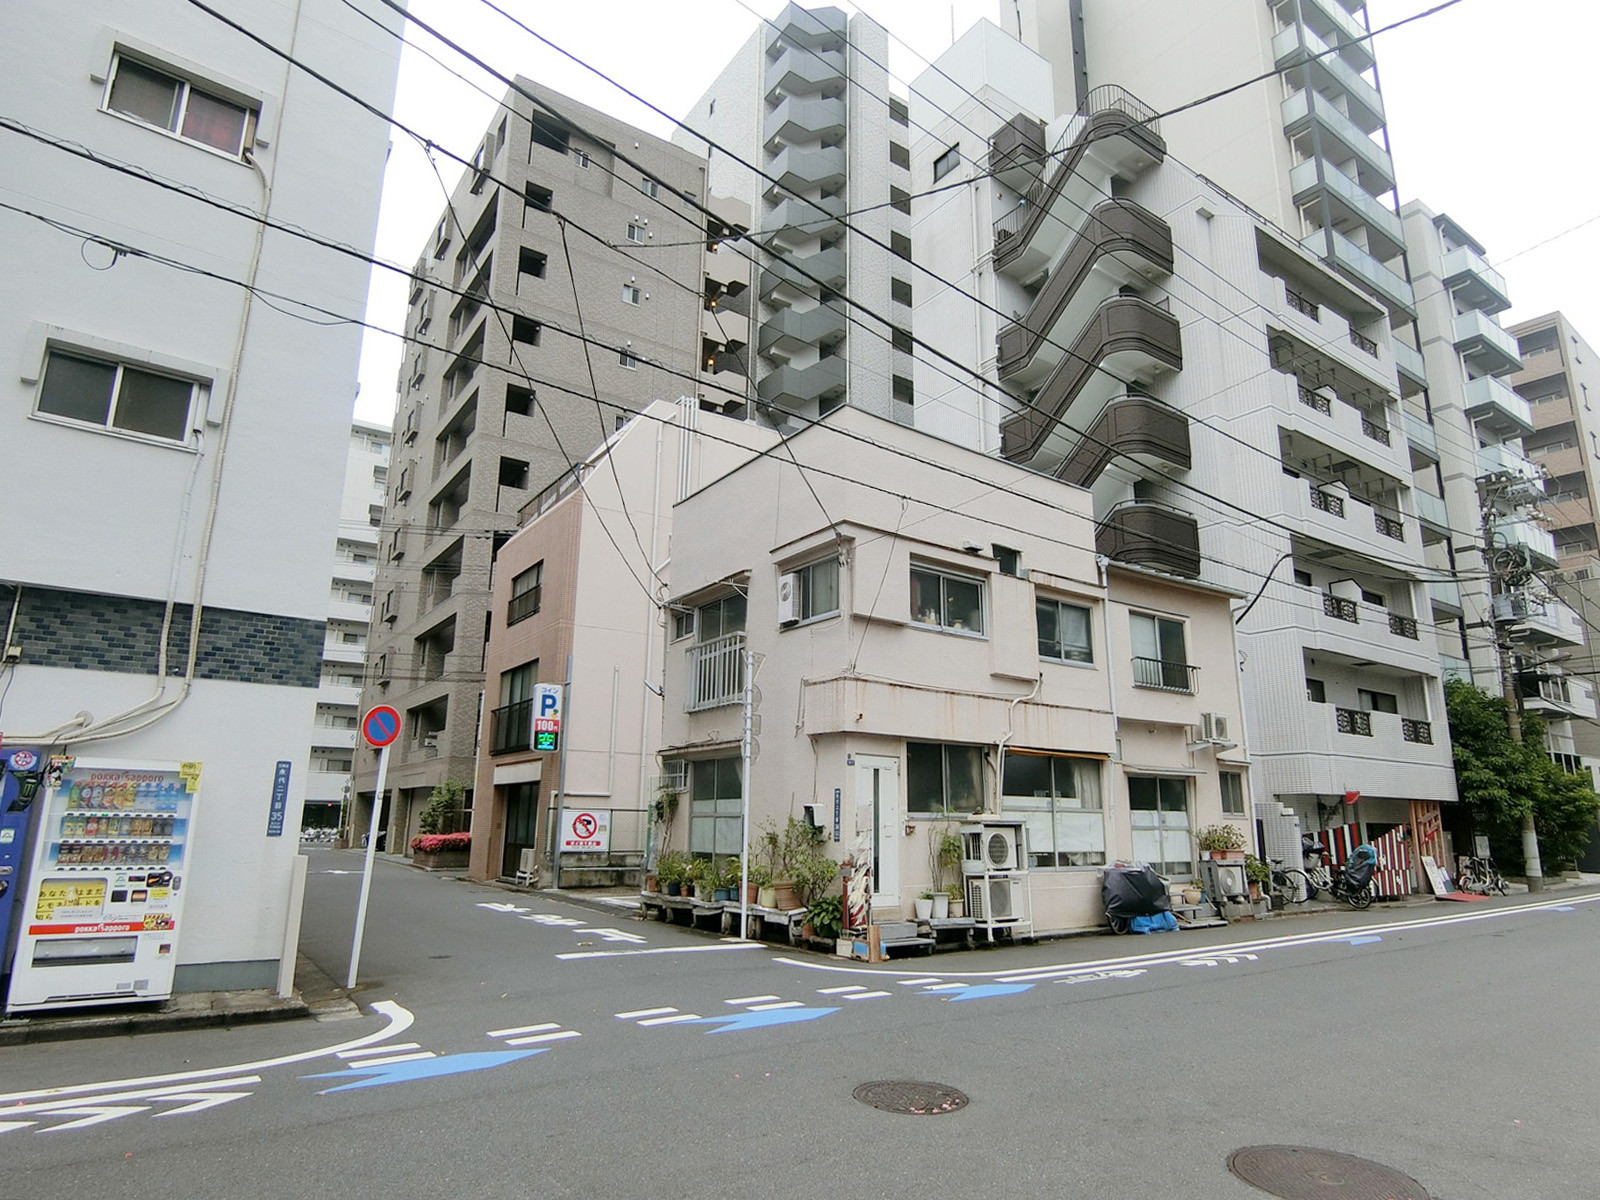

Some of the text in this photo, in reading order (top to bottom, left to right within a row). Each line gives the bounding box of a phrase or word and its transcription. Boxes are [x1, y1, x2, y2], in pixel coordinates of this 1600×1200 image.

[541, 694, 556, 717] P
[536, 720, 558, 731] 100円
[537, 733, 555, 750] 空
[271, 811, 283, 821] 35
